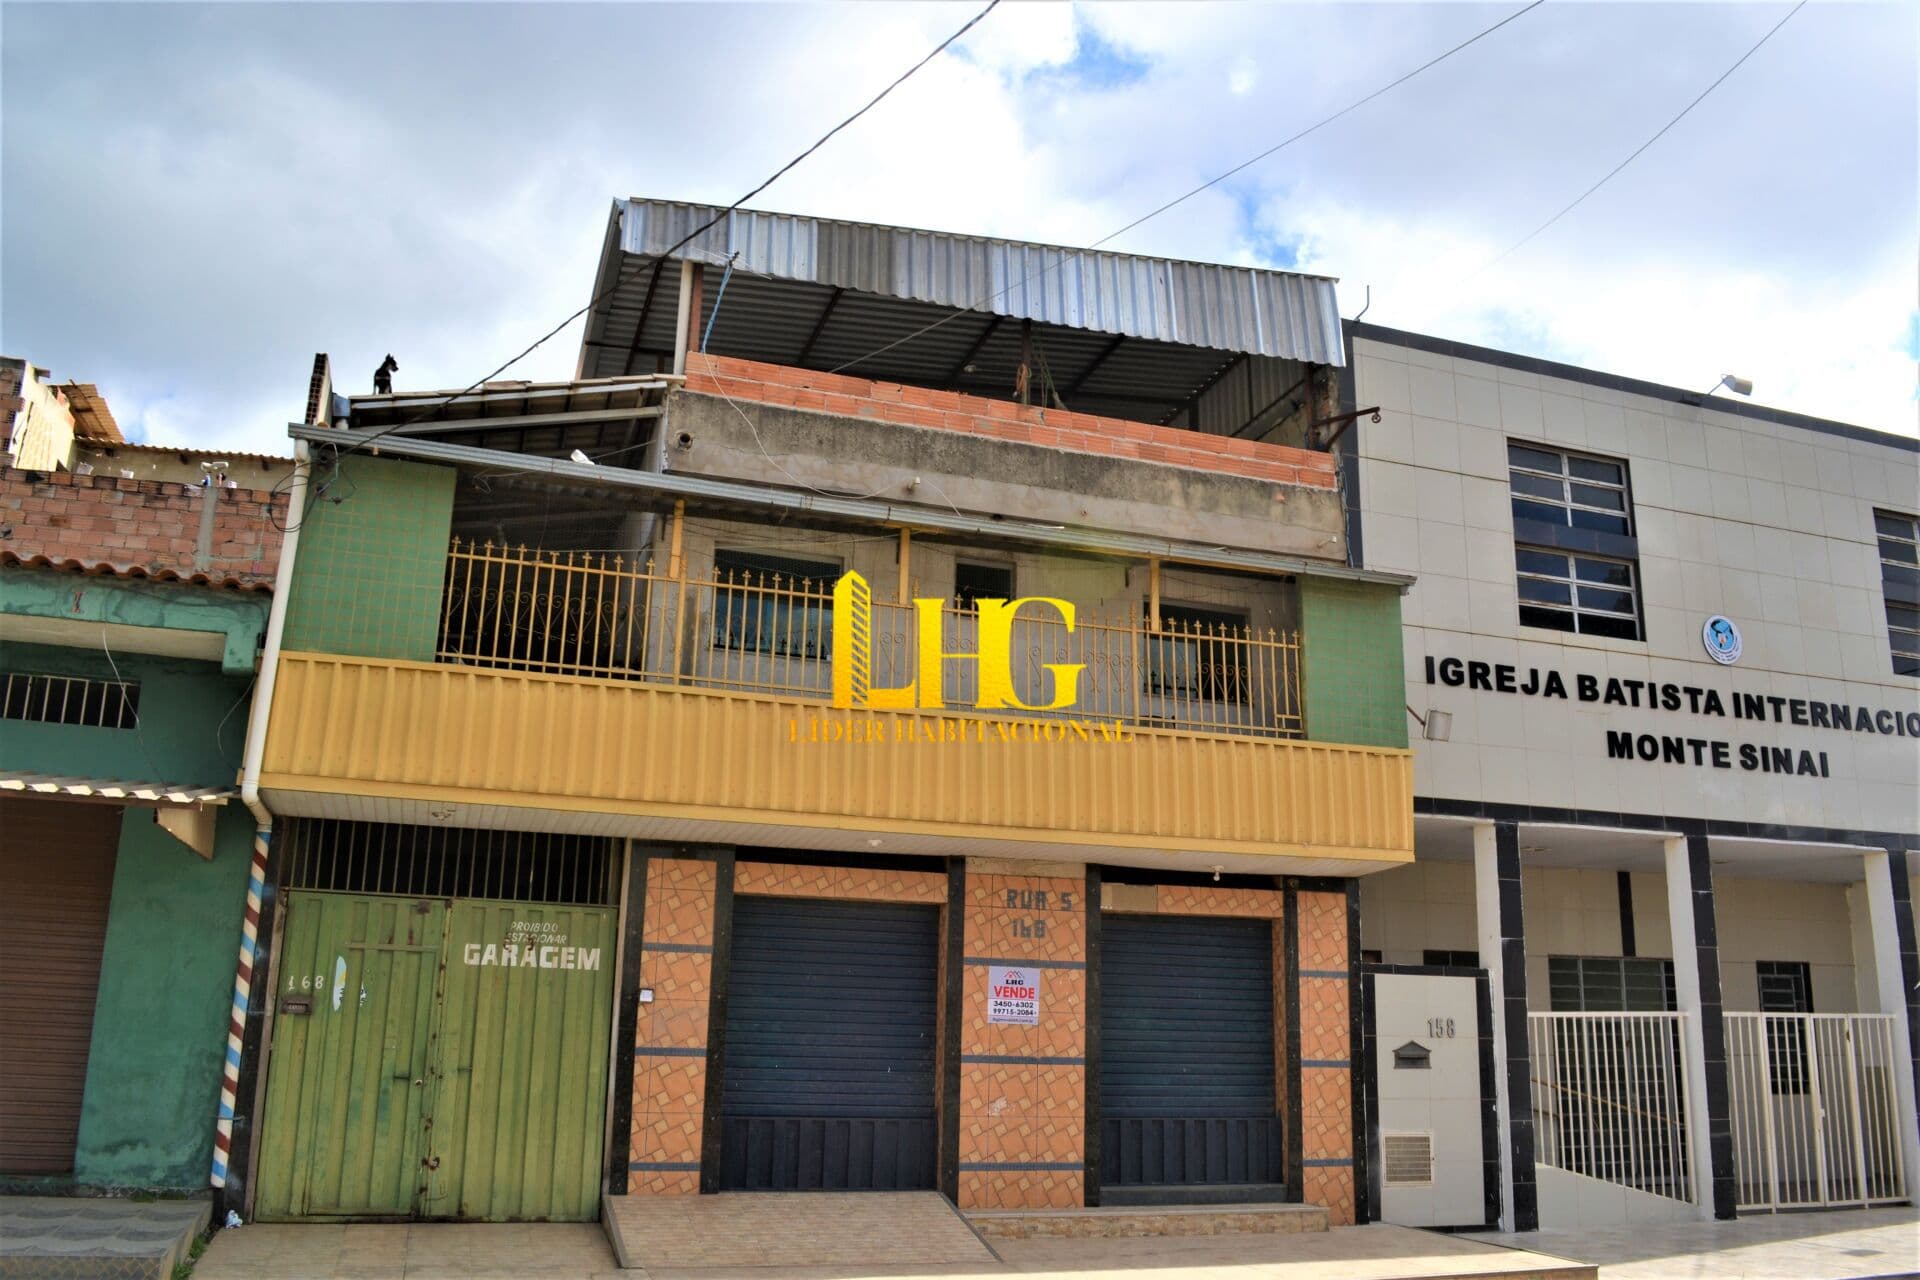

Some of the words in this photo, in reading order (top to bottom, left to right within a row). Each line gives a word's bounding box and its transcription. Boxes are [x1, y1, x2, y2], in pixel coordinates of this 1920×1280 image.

[1425, 655, 1568, 699] IGREJA
[1577, 673, 1726, 717] BATISTA
[1732, 692, 1920, 738] INTERNACIO
[1607, 731, 1732, 769] MONTE
[1740, 743, 1830, 778] SINAI
[1006, 889, 1048, 911] RUA
[1011, 918, 1047, 939] 168
[464, 943, 600, 971] GARAGEM
[288, 975, 324, 991] 168
[994, 985, 1035, 999] VENDE
[1427, 1018, 1455, 1038] 158
